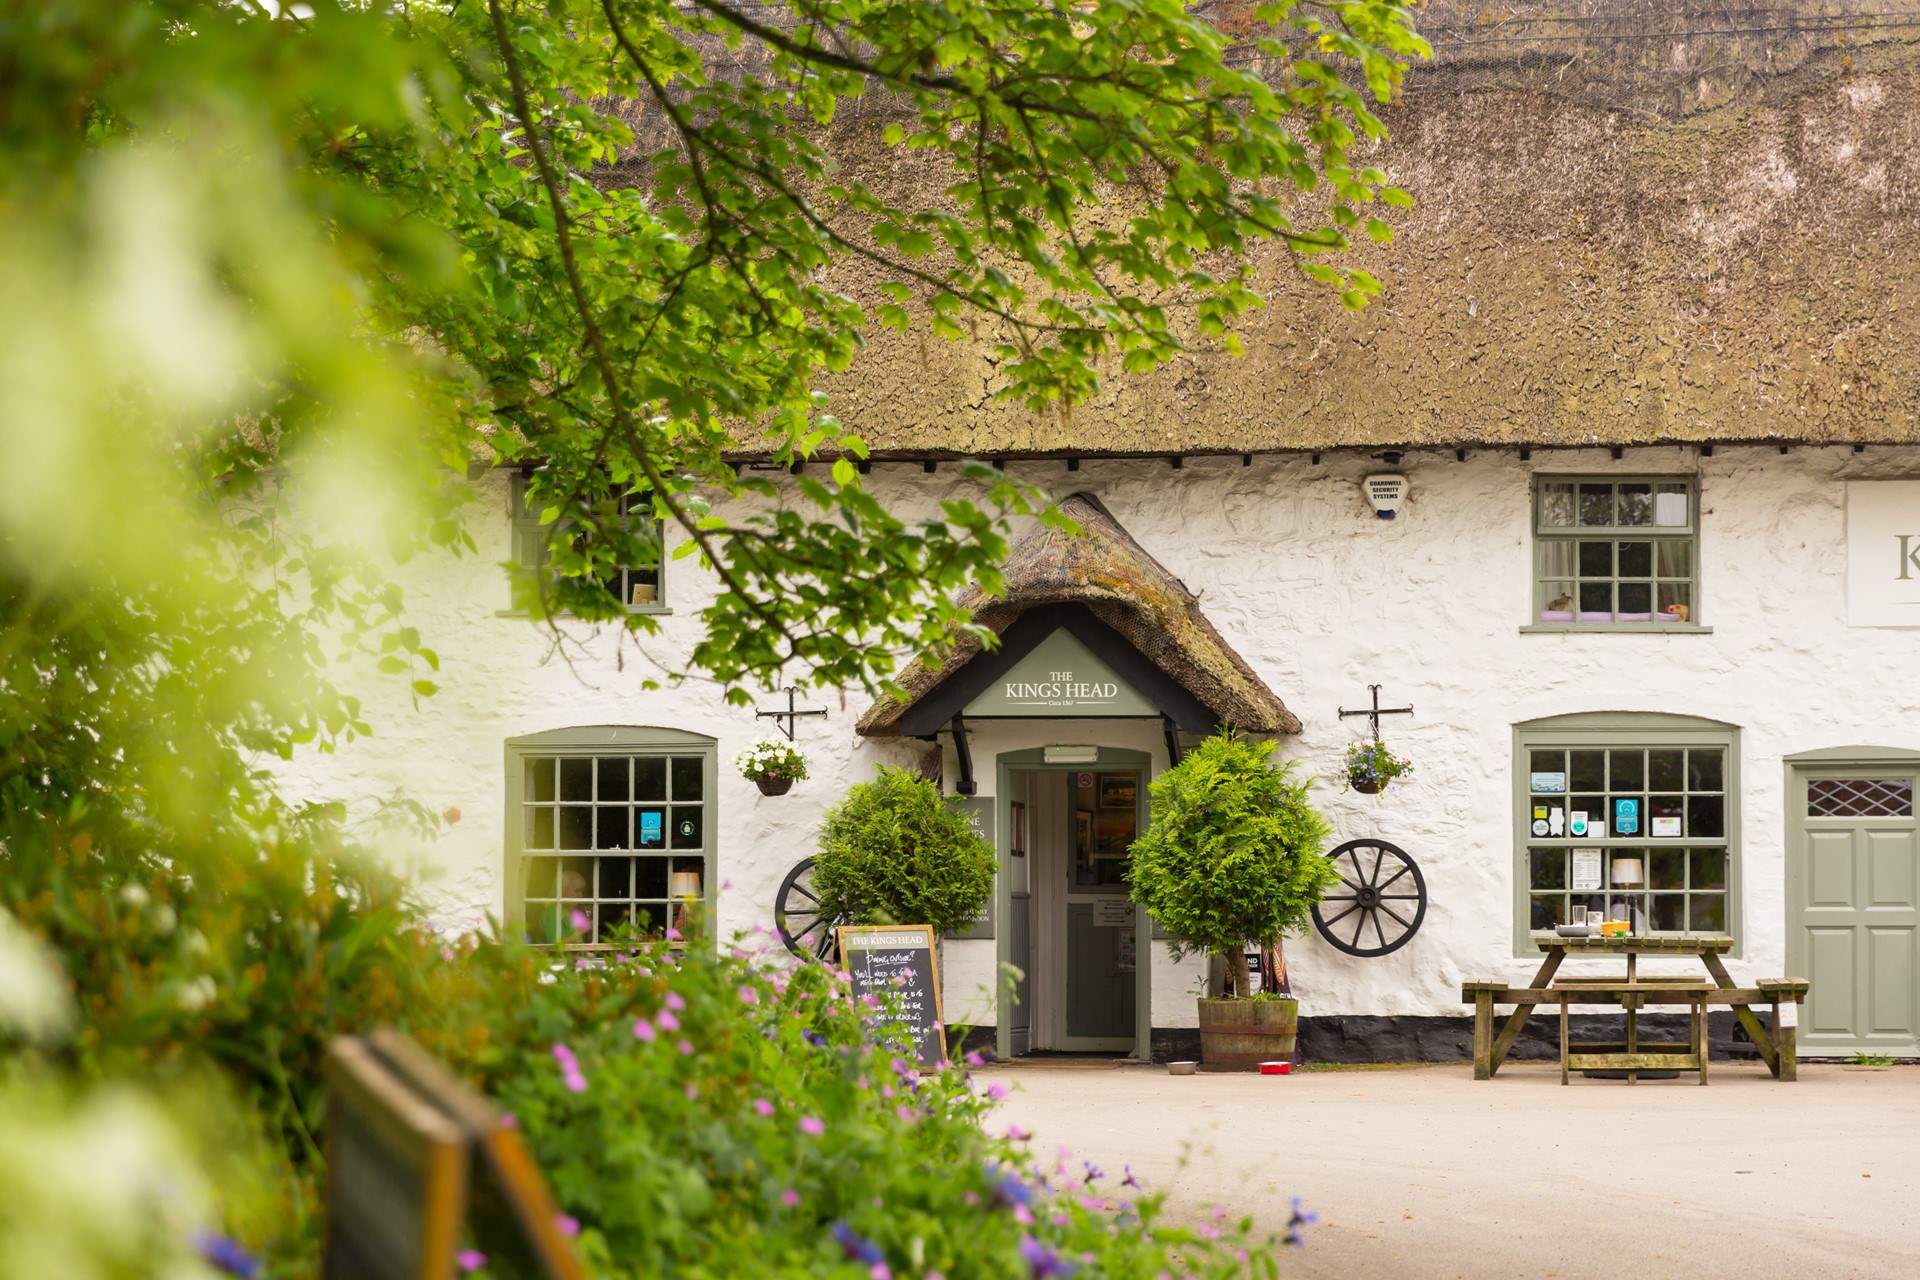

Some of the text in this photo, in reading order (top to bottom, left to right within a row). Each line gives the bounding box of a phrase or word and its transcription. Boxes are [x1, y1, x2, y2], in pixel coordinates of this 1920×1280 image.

[1049, 672, 1073, 681] THE
[1006, 683, 1118, 698] KINGS HEAD
[853, 935, 923, 945] THE KINGS HEAD
